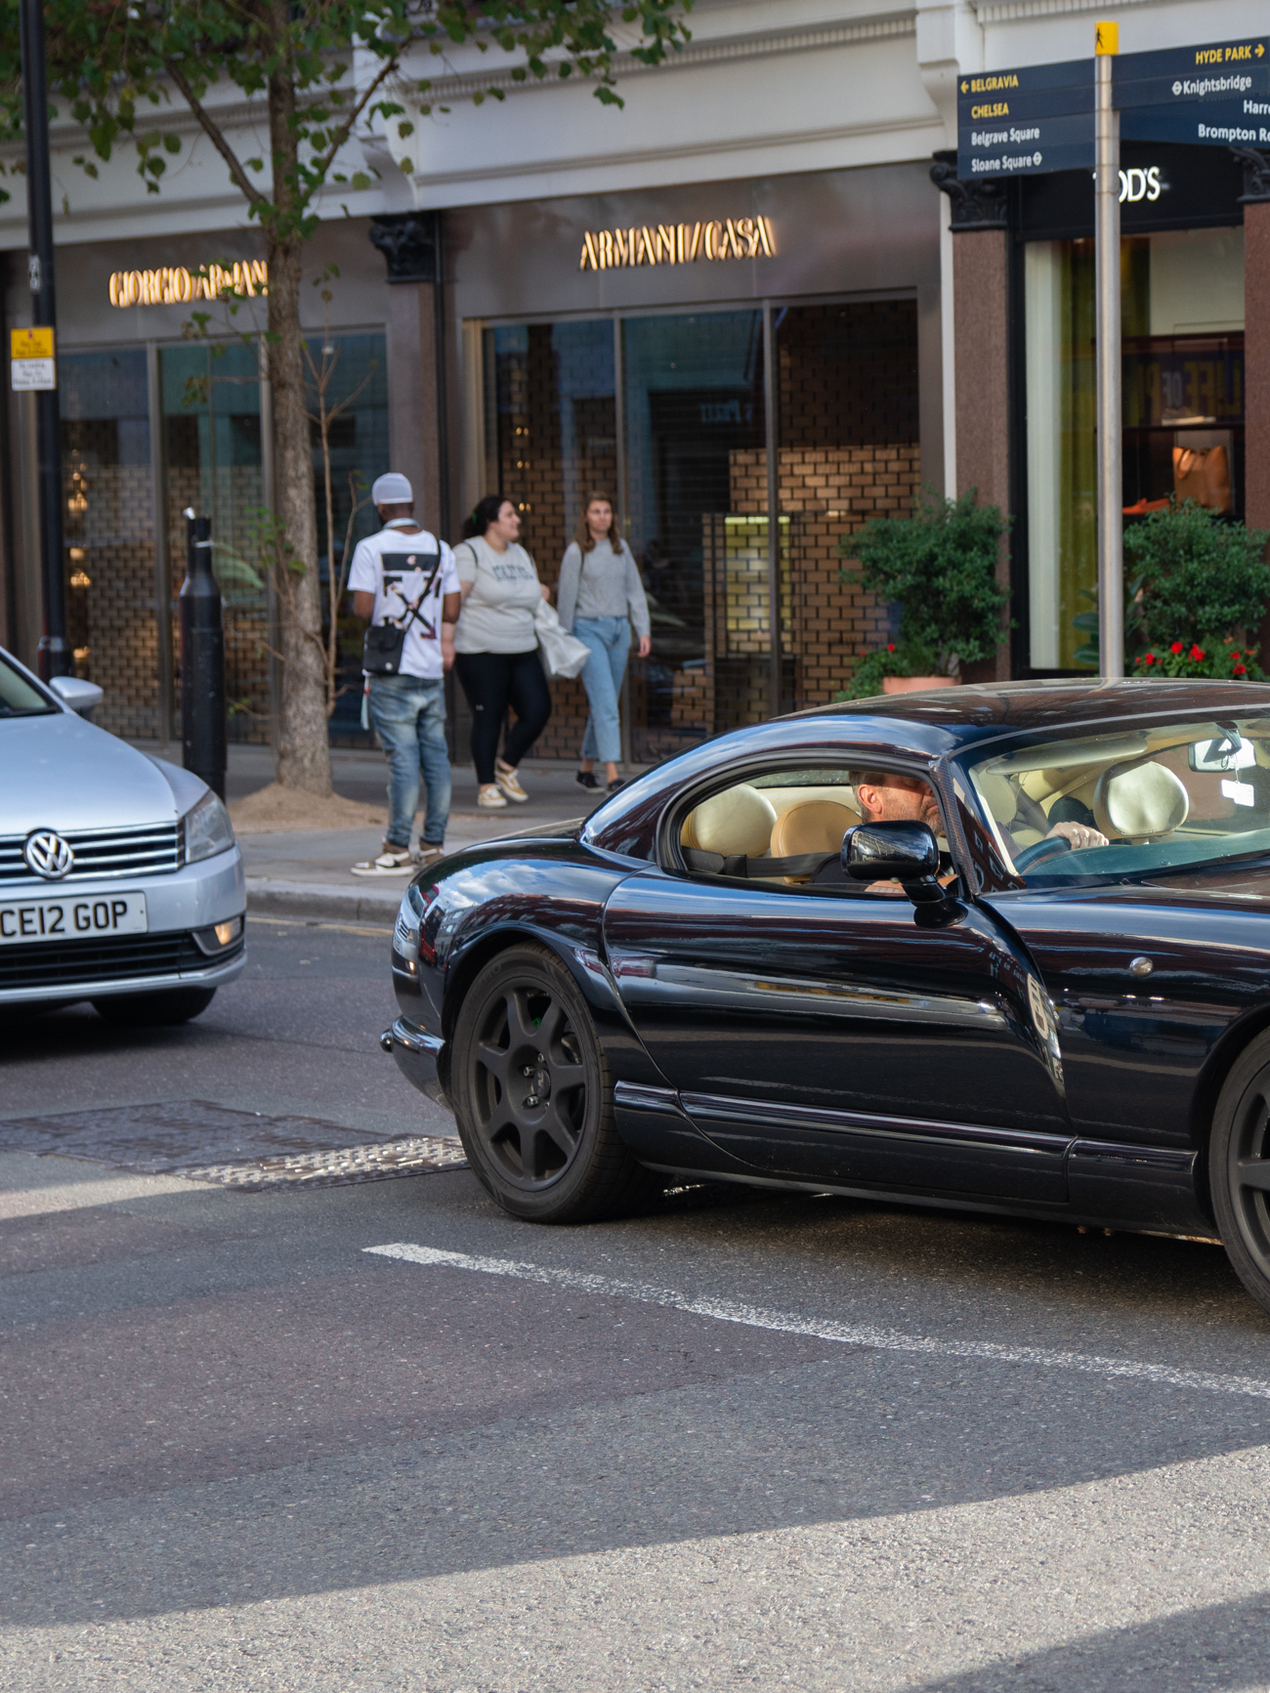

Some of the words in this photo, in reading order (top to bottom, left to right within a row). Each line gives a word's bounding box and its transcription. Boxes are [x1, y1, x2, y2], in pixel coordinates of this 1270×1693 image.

[1195, 48, 1223, 65] HYDE
[1225, 45, 1252, 62] PARK
[971, 74, 1019, 93] BELGRAVIA
[1183, 74, 1252, 96] Knightsbridge
[971, 102, 1009, 119] CHELSEA
[971, 131, 1008, 148] Belgrave
[1009, 127, 1040, 144] Square
[1198, 123, 1256, 143] Brompton
[971, 158, 1000, 173] Sloane
[1001, 155, 1032, 172] Square
[1092, 165, 1161, 203] D'S
[579, 214, 775, 271] ARMANI/CASA
[196, 259, 269, 300] ARMAN
[0, 905, 66, 938] CE12
[73, 901, 128, 932] GOP
